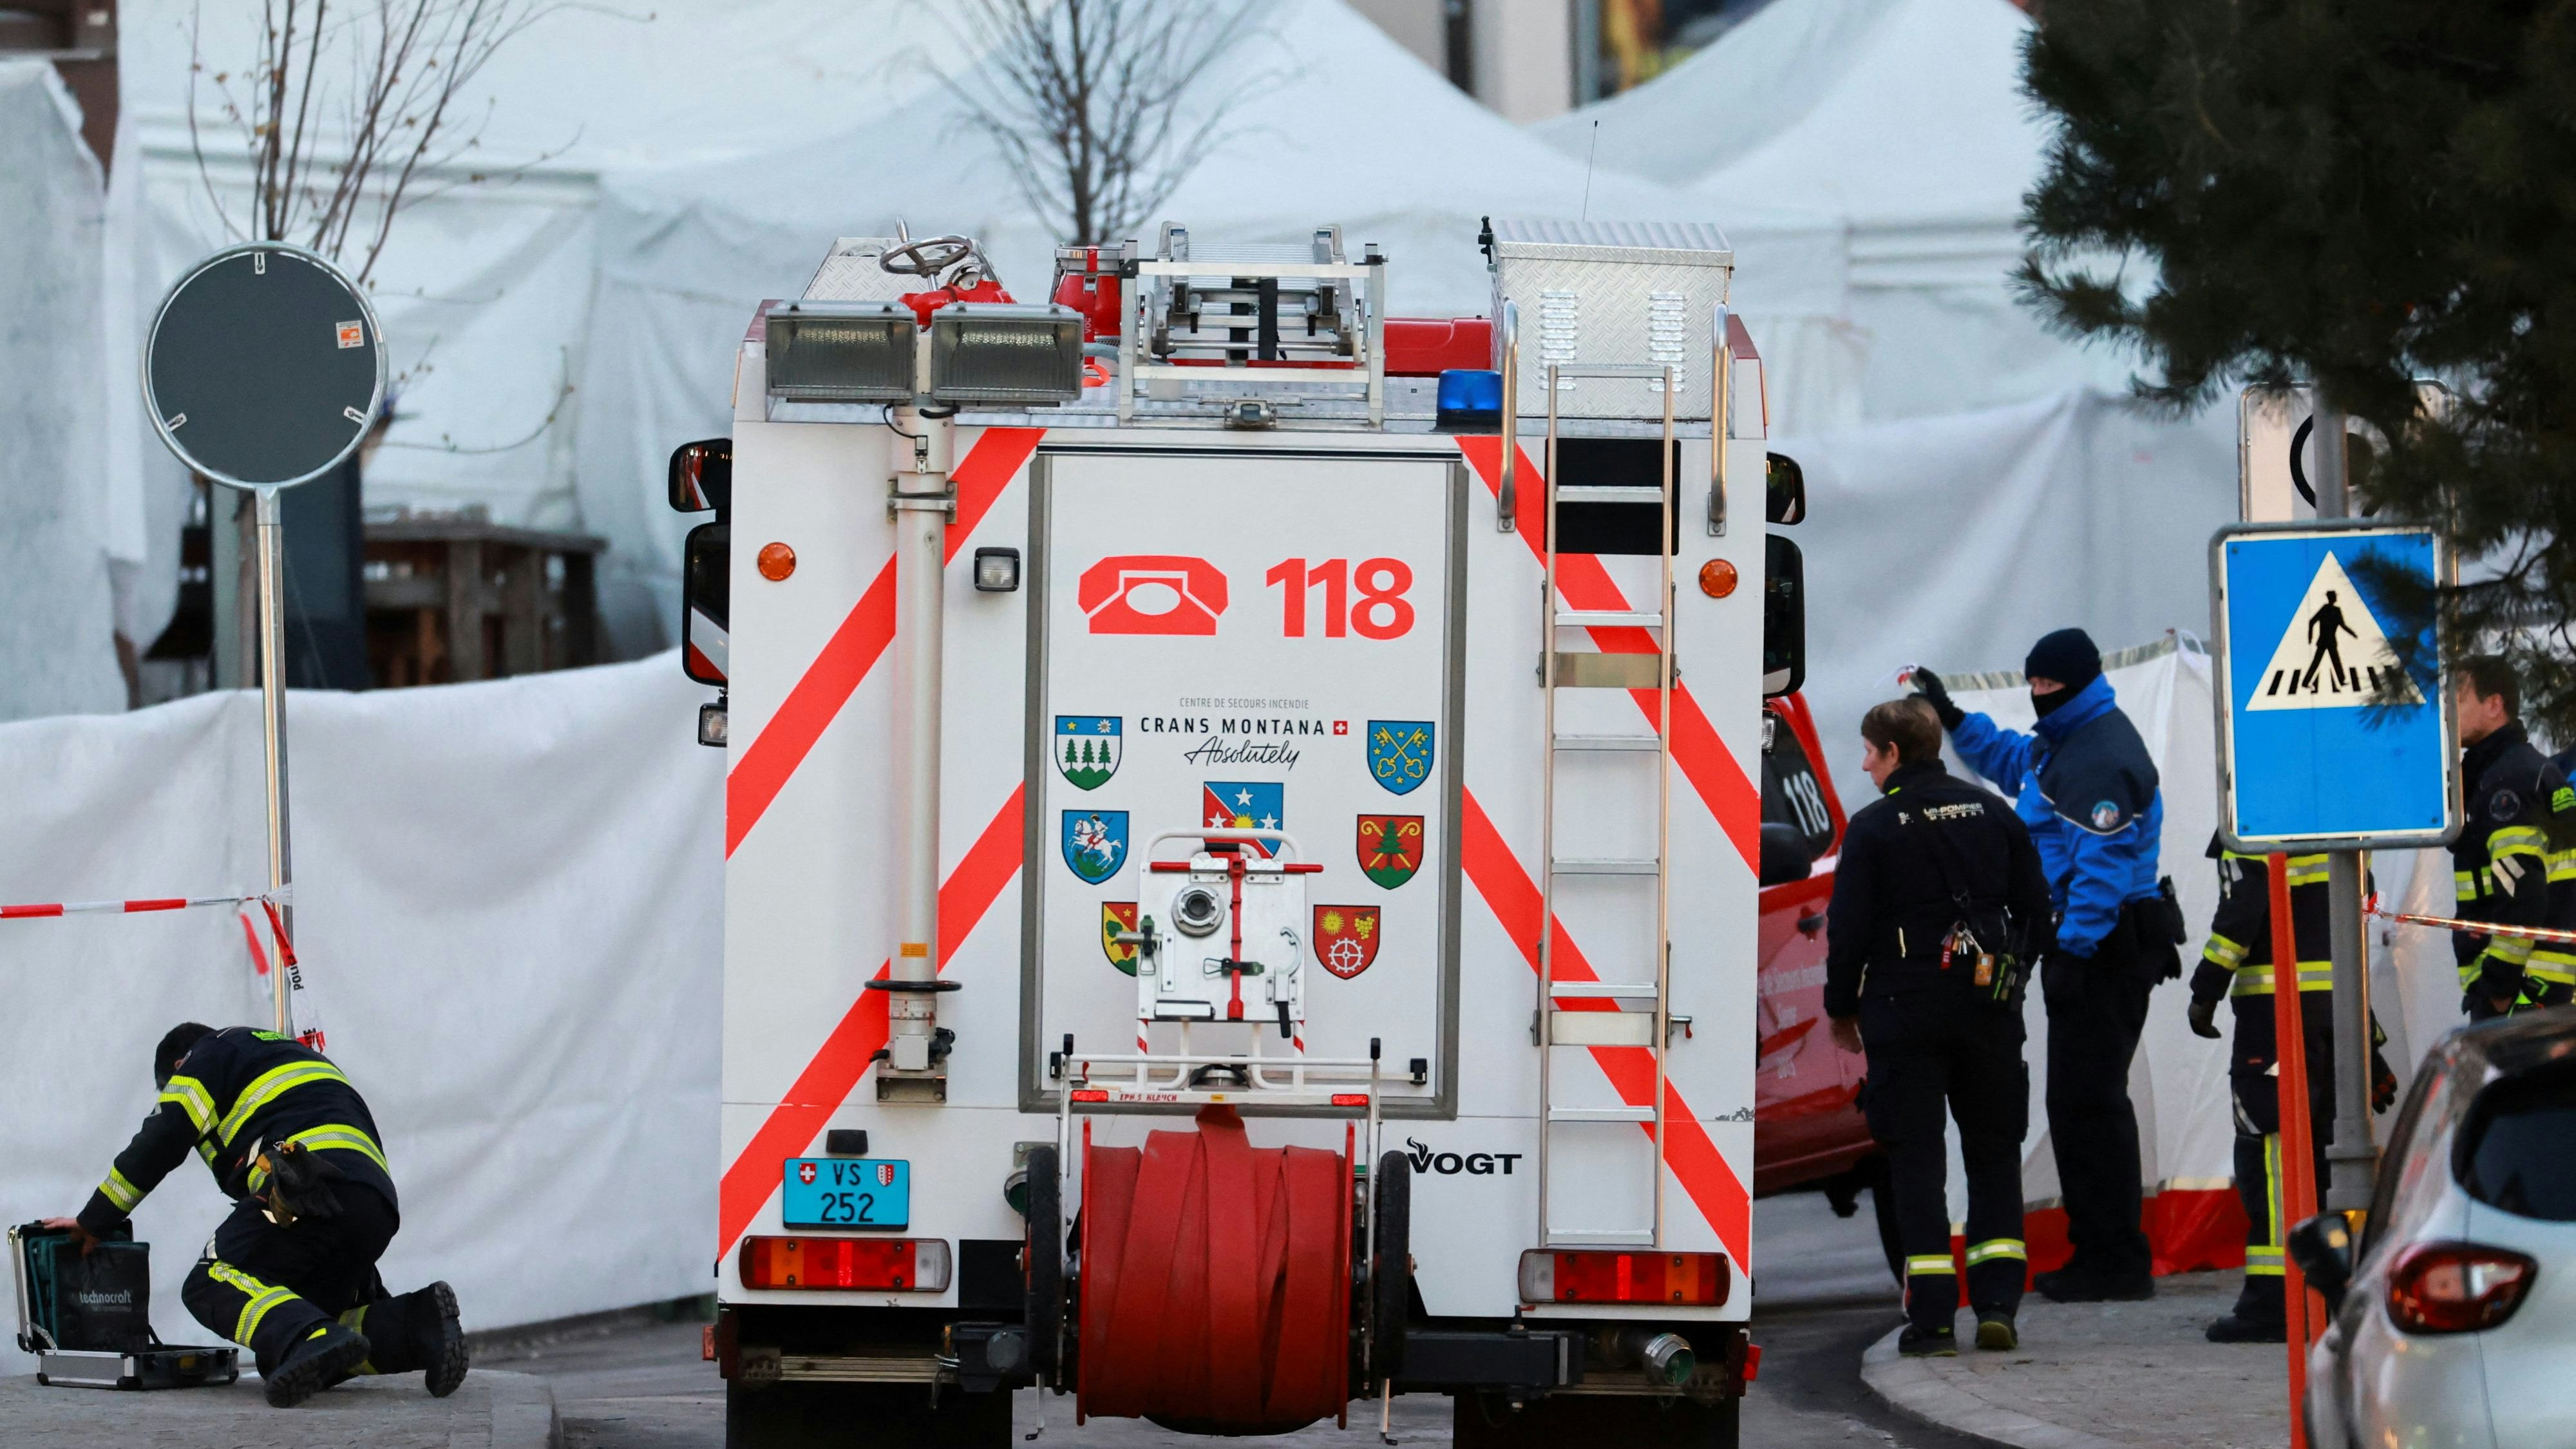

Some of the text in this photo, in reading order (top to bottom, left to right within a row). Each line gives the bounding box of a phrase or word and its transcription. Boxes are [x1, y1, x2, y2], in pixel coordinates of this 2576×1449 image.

[1266, 558, 1415, 640] 118
[1180, 697, 1309, 709] CENTRE DE SECOURS INCENDIE
[1141, 717, 1325, 735] CRANS MONTANA
[1184, 735, 1300, 772] Absolutely
[1783, 770, 1829, 837] 118
[833, 1163, 861, 1186] VS
[1407, 1152, 1522, 1175] VOGT
[820, 1192, 874, 1222] 252
[79, 1289, 132, 1304] technocraft
